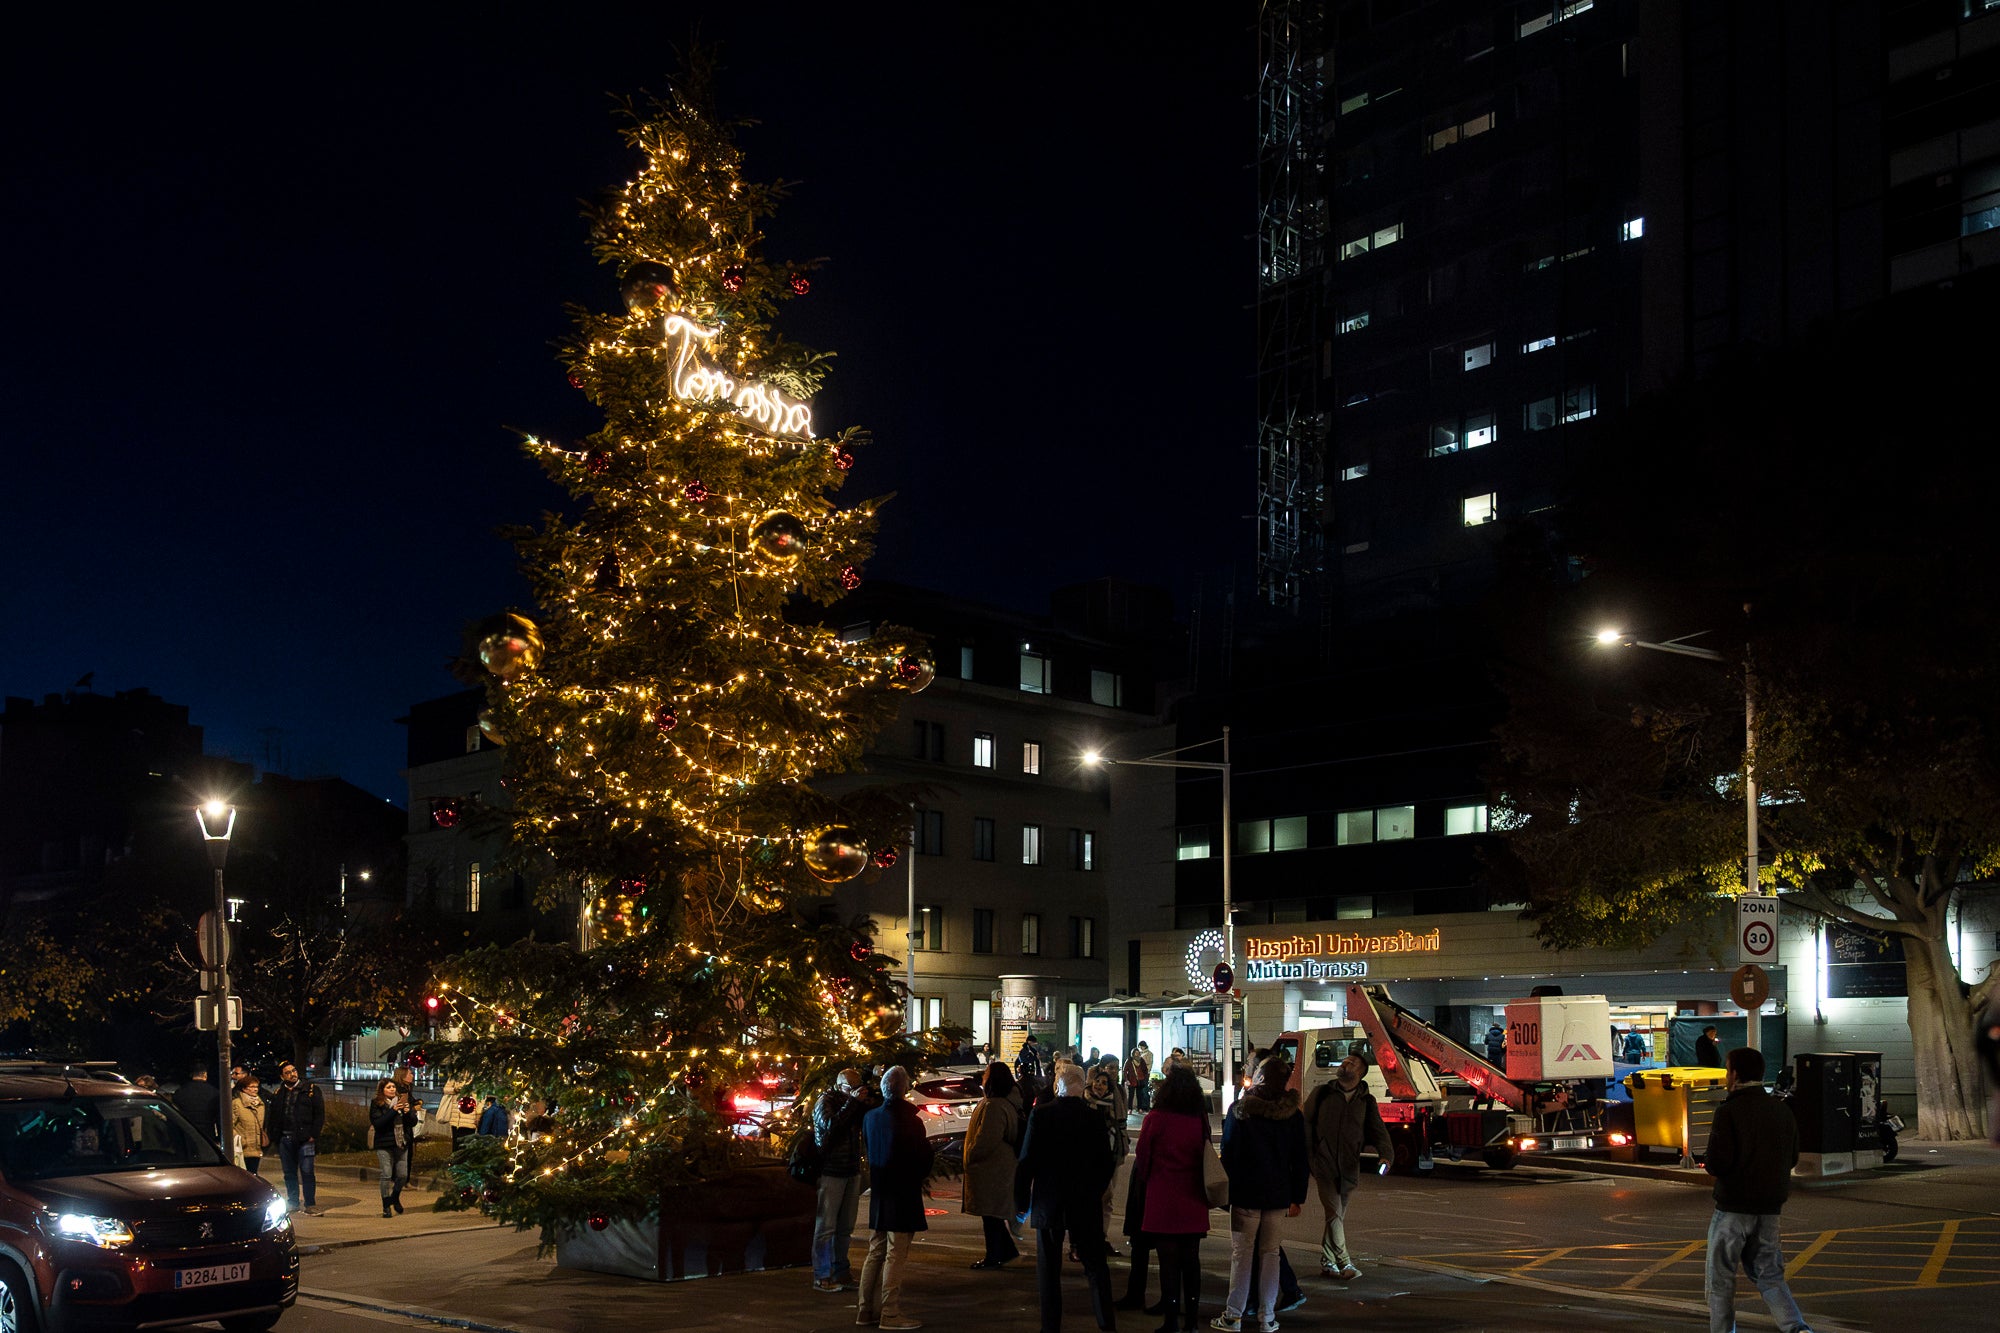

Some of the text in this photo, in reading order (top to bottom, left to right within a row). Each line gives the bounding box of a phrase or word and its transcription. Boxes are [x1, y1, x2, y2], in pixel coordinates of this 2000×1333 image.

[1742, 903, 1775, 913] ZONA
[1246, 928, 1440, 961] Hospital Universitari
[1750, 933, 1768, 944] 30
[185, 1264, 247, 1285] 3284 LGY
